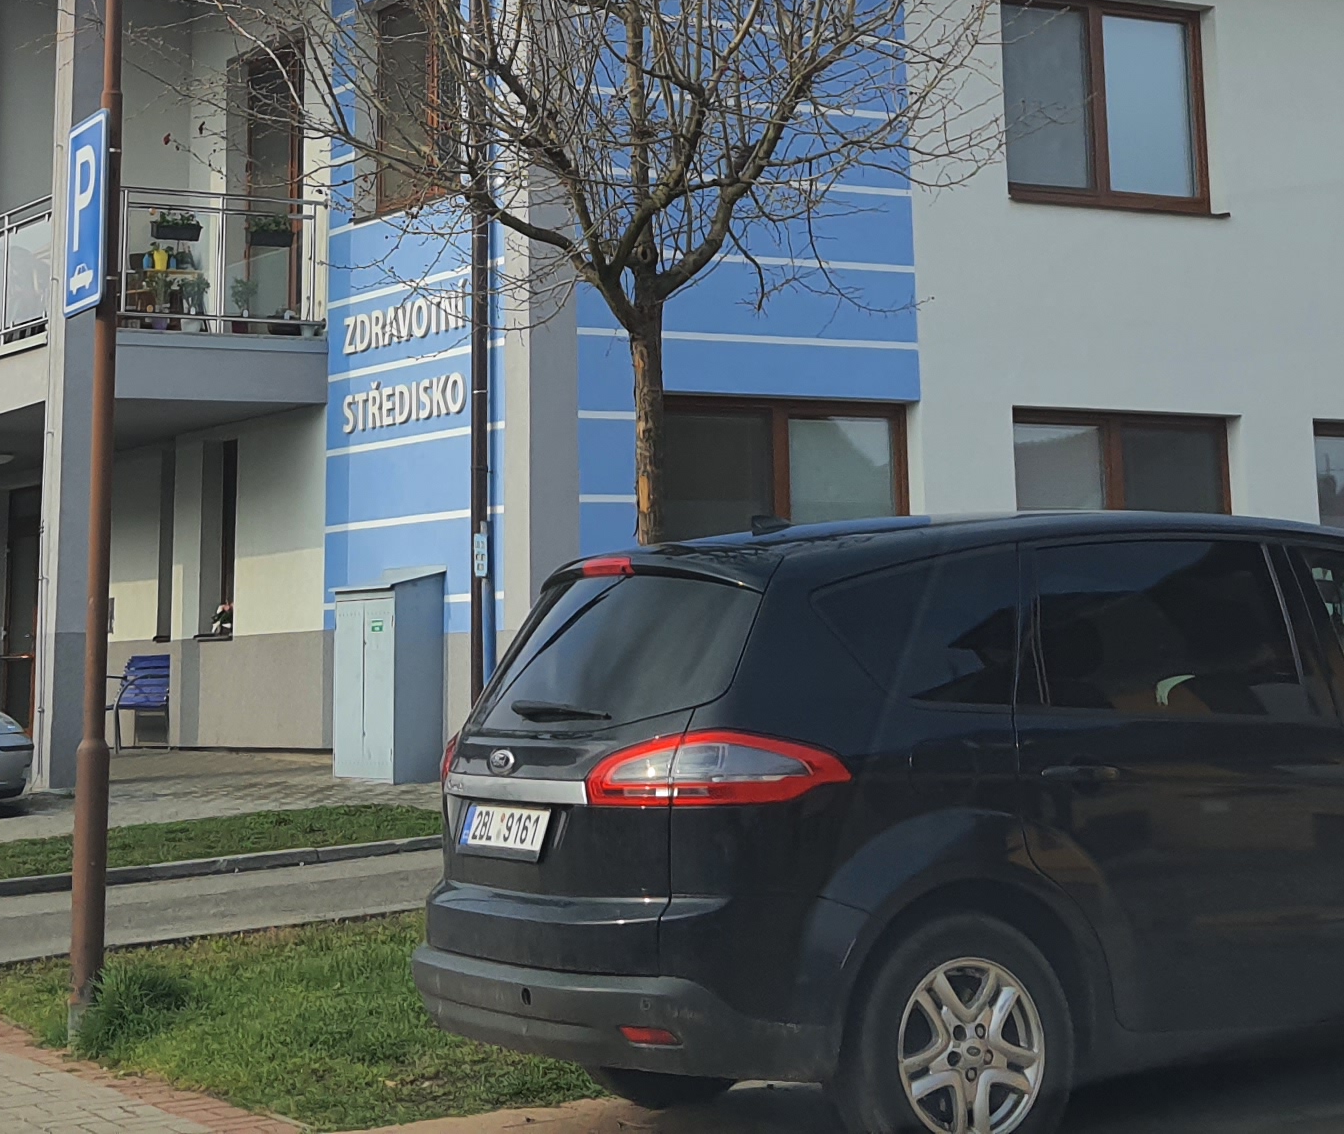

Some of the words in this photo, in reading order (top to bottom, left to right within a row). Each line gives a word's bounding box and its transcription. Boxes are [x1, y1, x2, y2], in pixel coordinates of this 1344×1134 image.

[73, 144, 96, 252] P
[343, 278, 468, 355] ZDRAVOTNÍ
[343, 372, 467, 434] STŘEDISKO
[471, 810, 494, 841] 2BL
[503, 812, 540, 846] 9161
